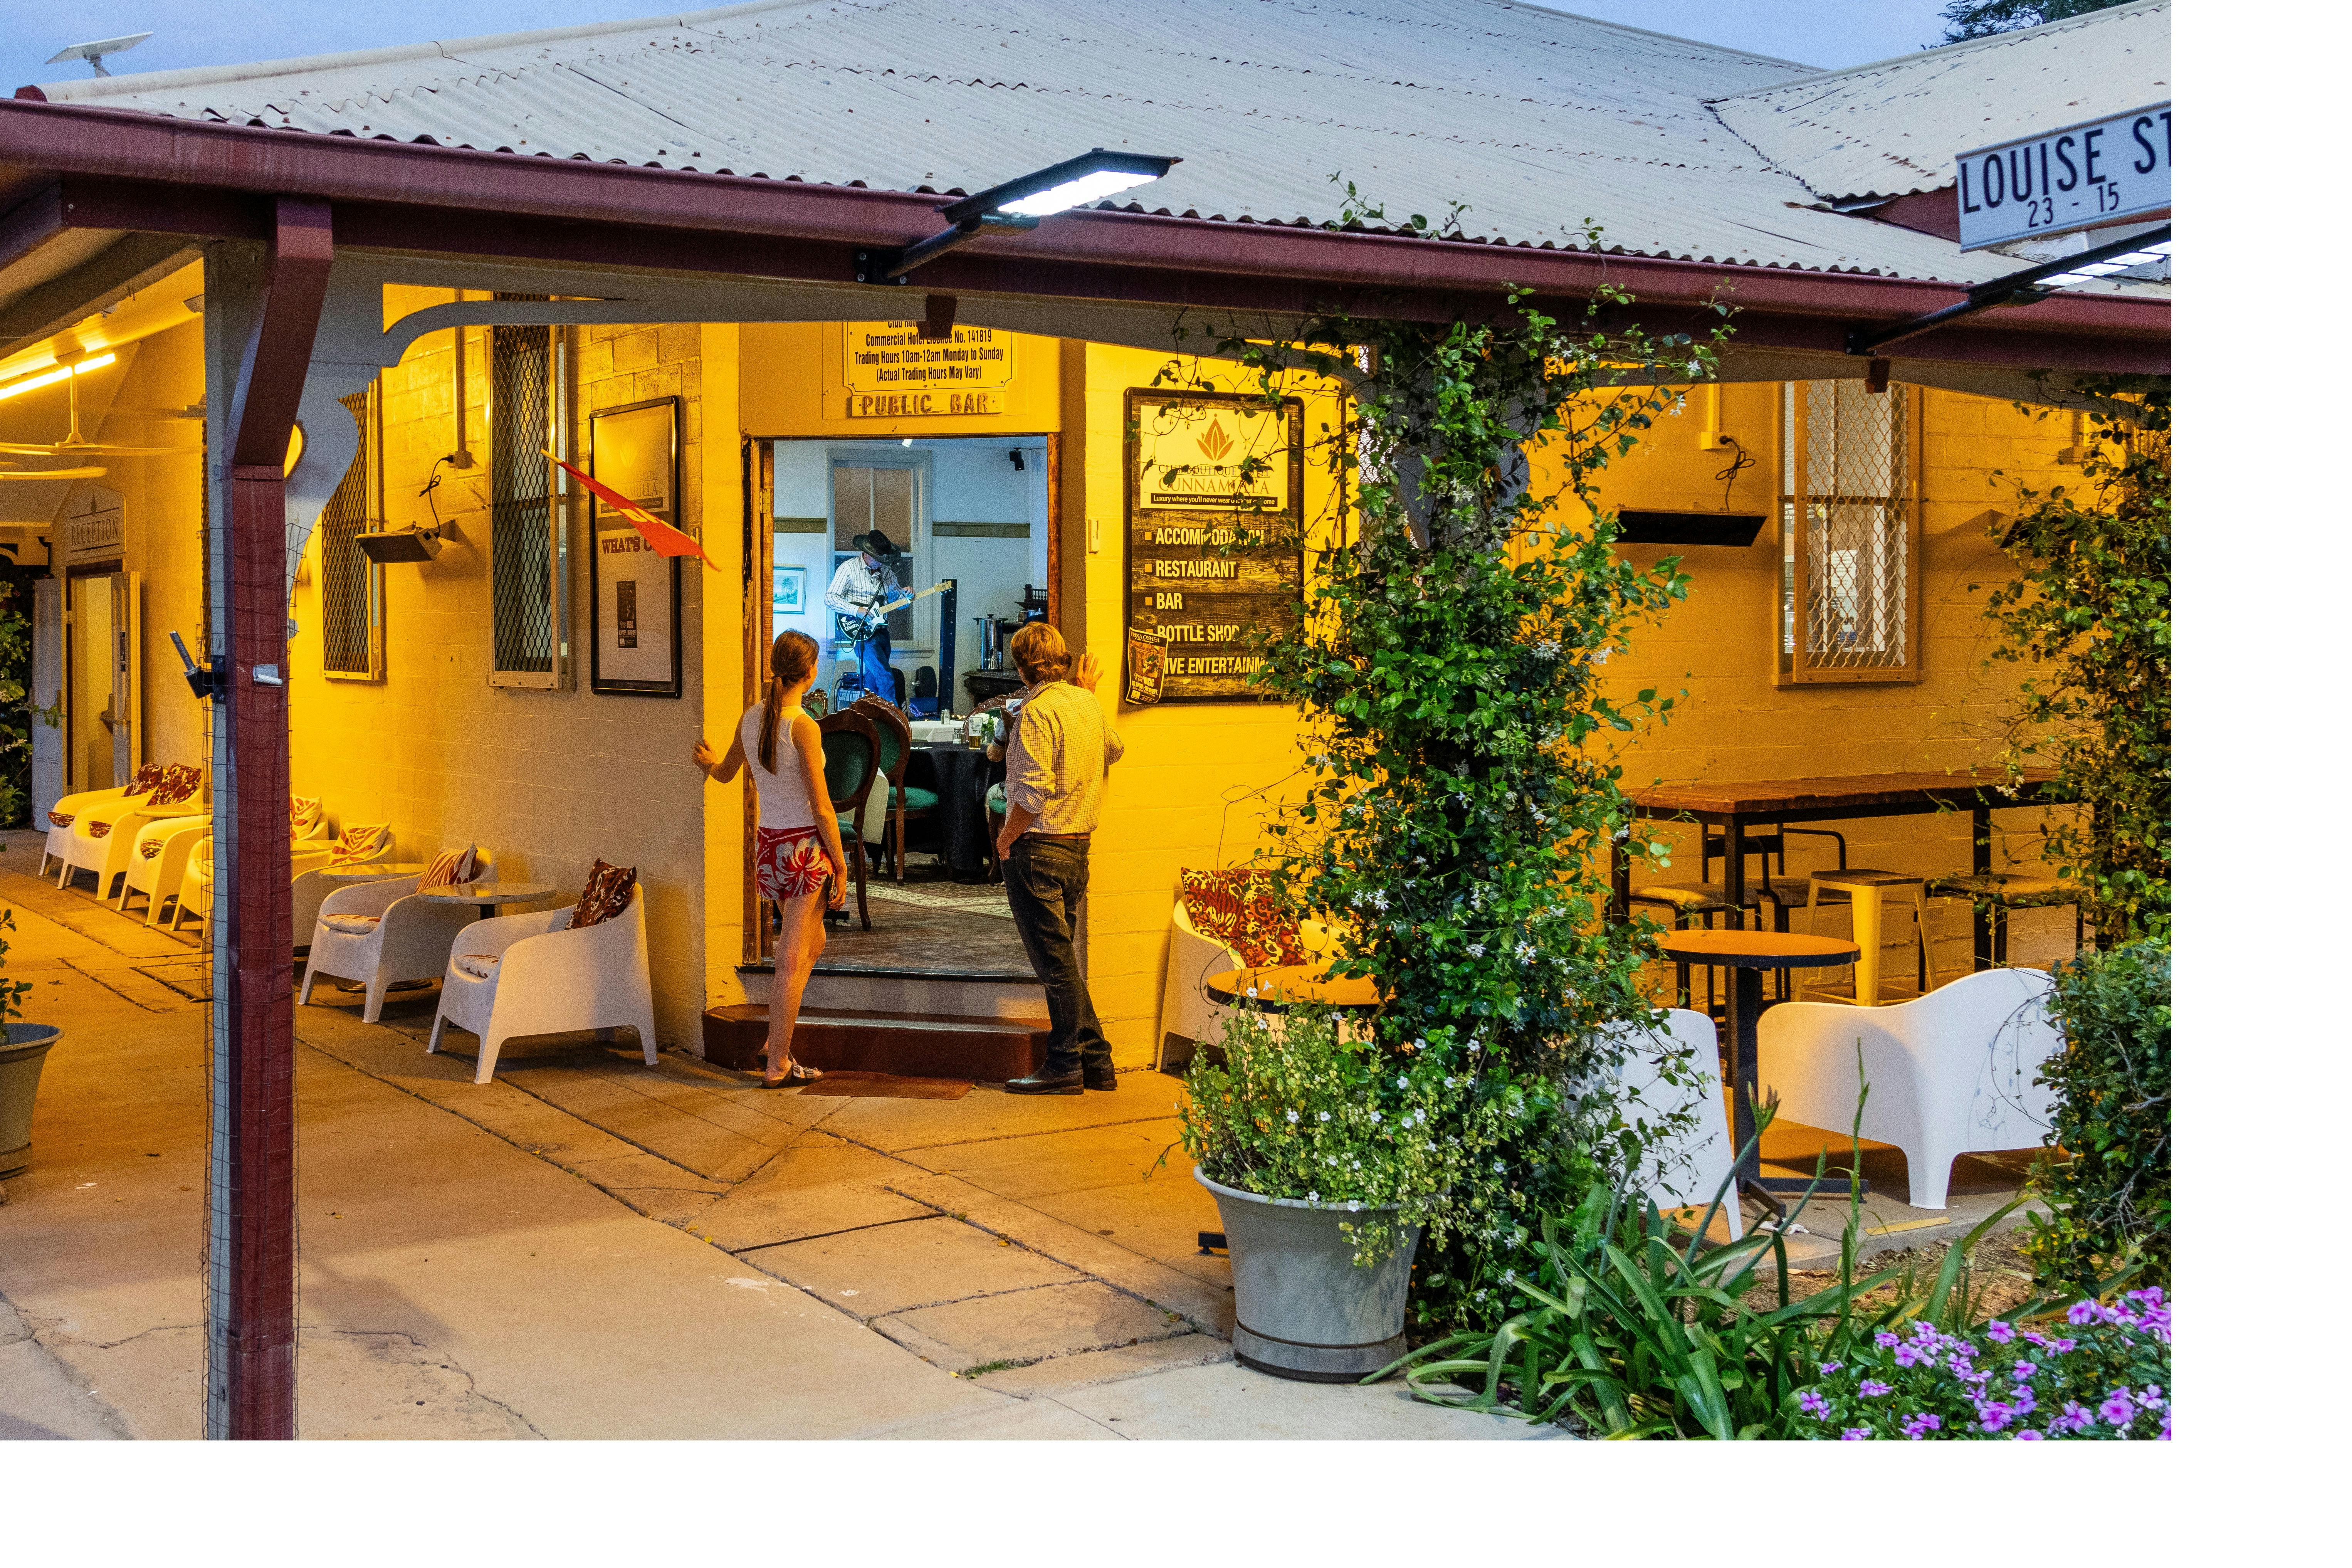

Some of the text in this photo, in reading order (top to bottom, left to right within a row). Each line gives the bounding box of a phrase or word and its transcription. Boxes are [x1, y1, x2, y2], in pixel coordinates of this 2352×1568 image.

[1961, 128, 2106, 214] LOUISE
[2028, 197, 2053, 228] 23
[2098, 182, 2120, 212] 15
[866, 332, 905, 347] Commercial
[954, 330, 965, 343] No.
[968, 329, 991, 343] 141819
[855, 347, 1003, 365] Trading Hours 10am-12am Monday to Sunday
[877, 365, 981, 383] (Actual Trading Hours May Vary)
[862, 393, 988, 415] PUBLIC BAR
[1153, 495, 1171, 503] Luxury
[71, 516, 118, 546] RECEPTION
[1156, 560, 1236, 578] RESTAURANT
[1156, 592, 1183, 610] BAR
[1157, 625, 1205, 642] BOTTLE
[1207, 625, 1240, 642] SHOP
[1164, 657, 1275, 674] IVE ENTERTAINM
